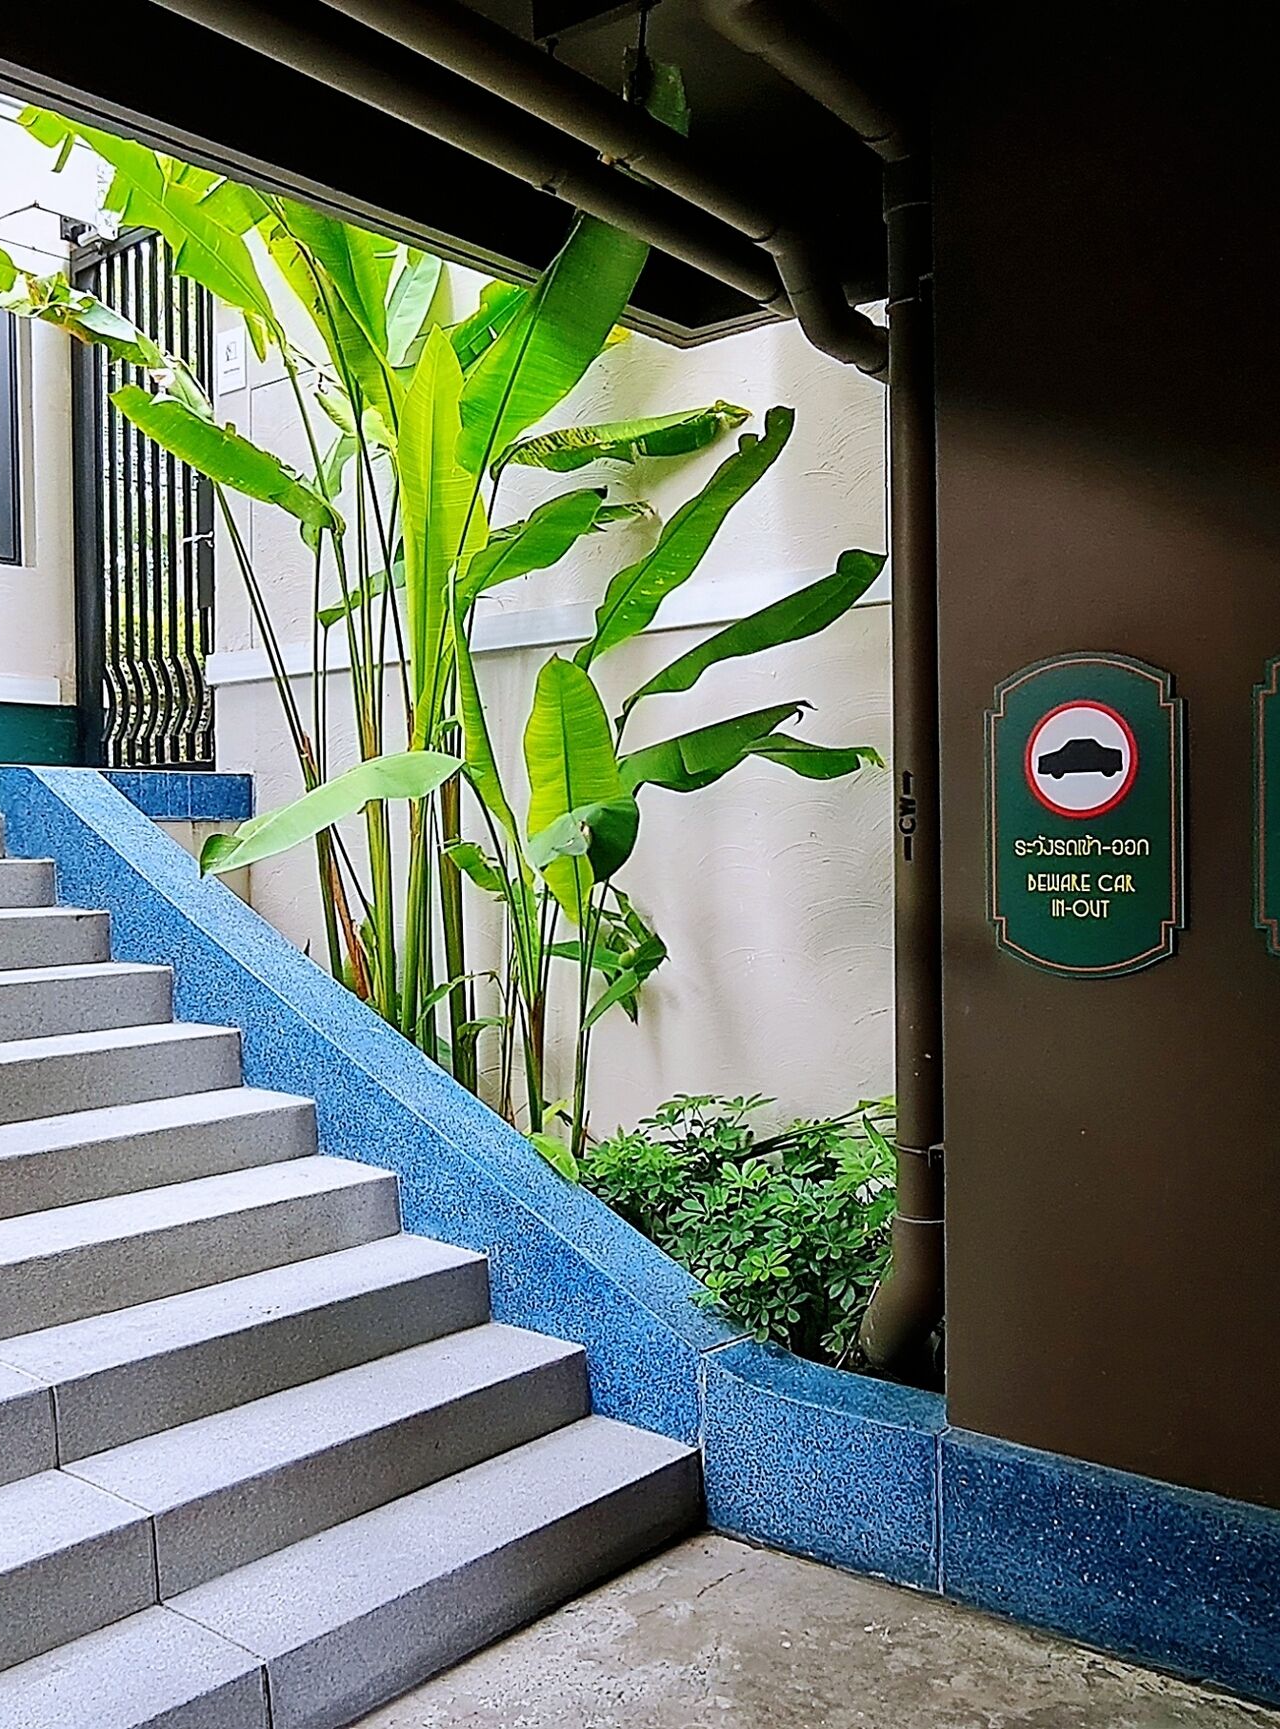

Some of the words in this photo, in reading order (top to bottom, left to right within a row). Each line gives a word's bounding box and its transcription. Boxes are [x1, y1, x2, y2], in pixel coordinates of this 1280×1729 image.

[1015, 834, 1150, 856] ระวังรถเข้า-ออก
[1028, 873, 1091, 892] BEWARE
[1098, 874, 1136, 893] CAR
[1051, 899, 1110, 918] IN-OUT
